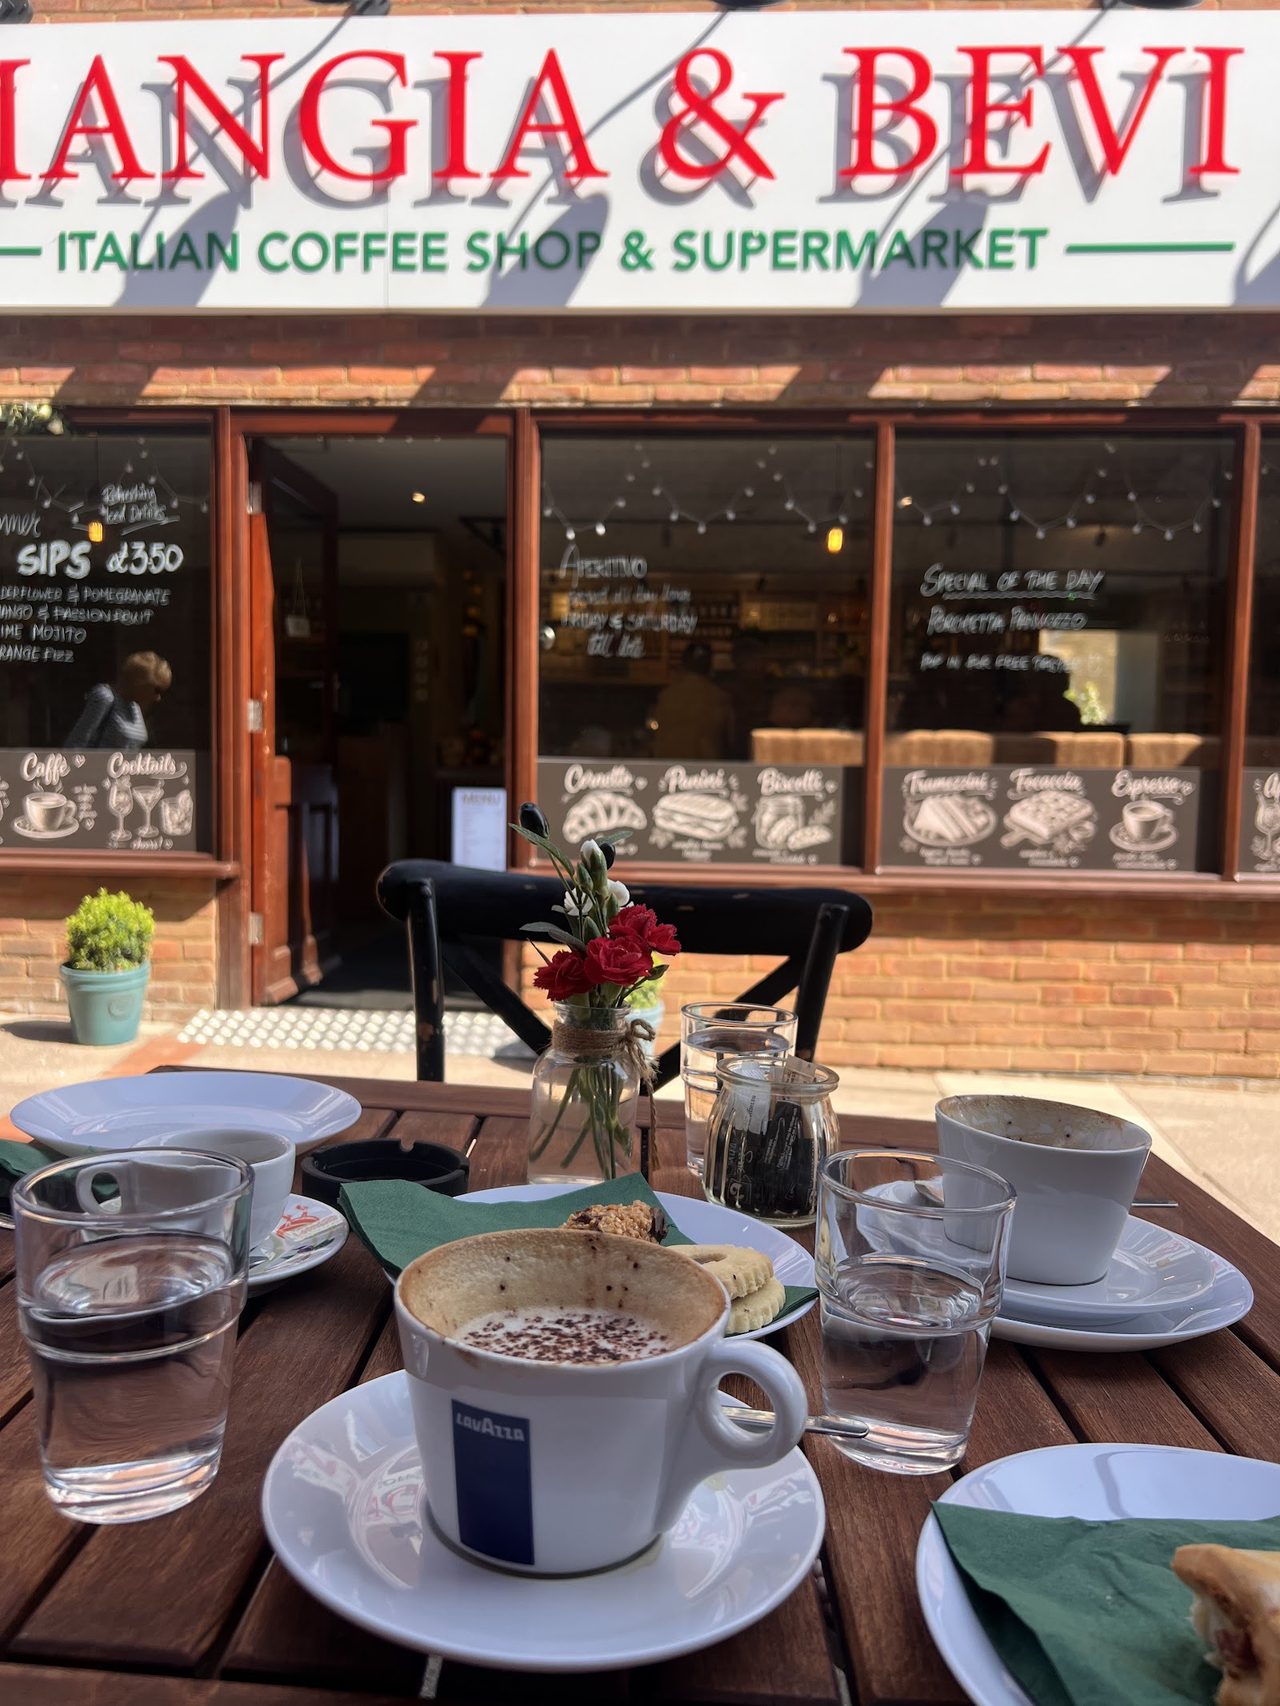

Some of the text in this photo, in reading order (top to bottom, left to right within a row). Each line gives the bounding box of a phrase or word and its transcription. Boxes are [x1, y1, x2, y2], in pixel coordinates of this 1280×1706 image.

[660, 47, 785, 180] &
[838, 46, 1244, 176] BEVI
[57, 228, 1049, 273] ITALIAN COFFEE SHOP & SUPERMARKET
[17, 539, 92, 579] SIPS
[1024, 569, 1058, 591] THE
[1066, 568, 1106, 593] DAY
[0, 585, 62, 602] DERFLOWER
[83, 587, 172, 606] POMEGRANATE
[0, 603, 33, 620] ANGO
[32, 623, 87, 644] MOJITO
[107, 752, 177, 779] Cocktails
[456, 1412, 526, 1442] LAVAZZA
